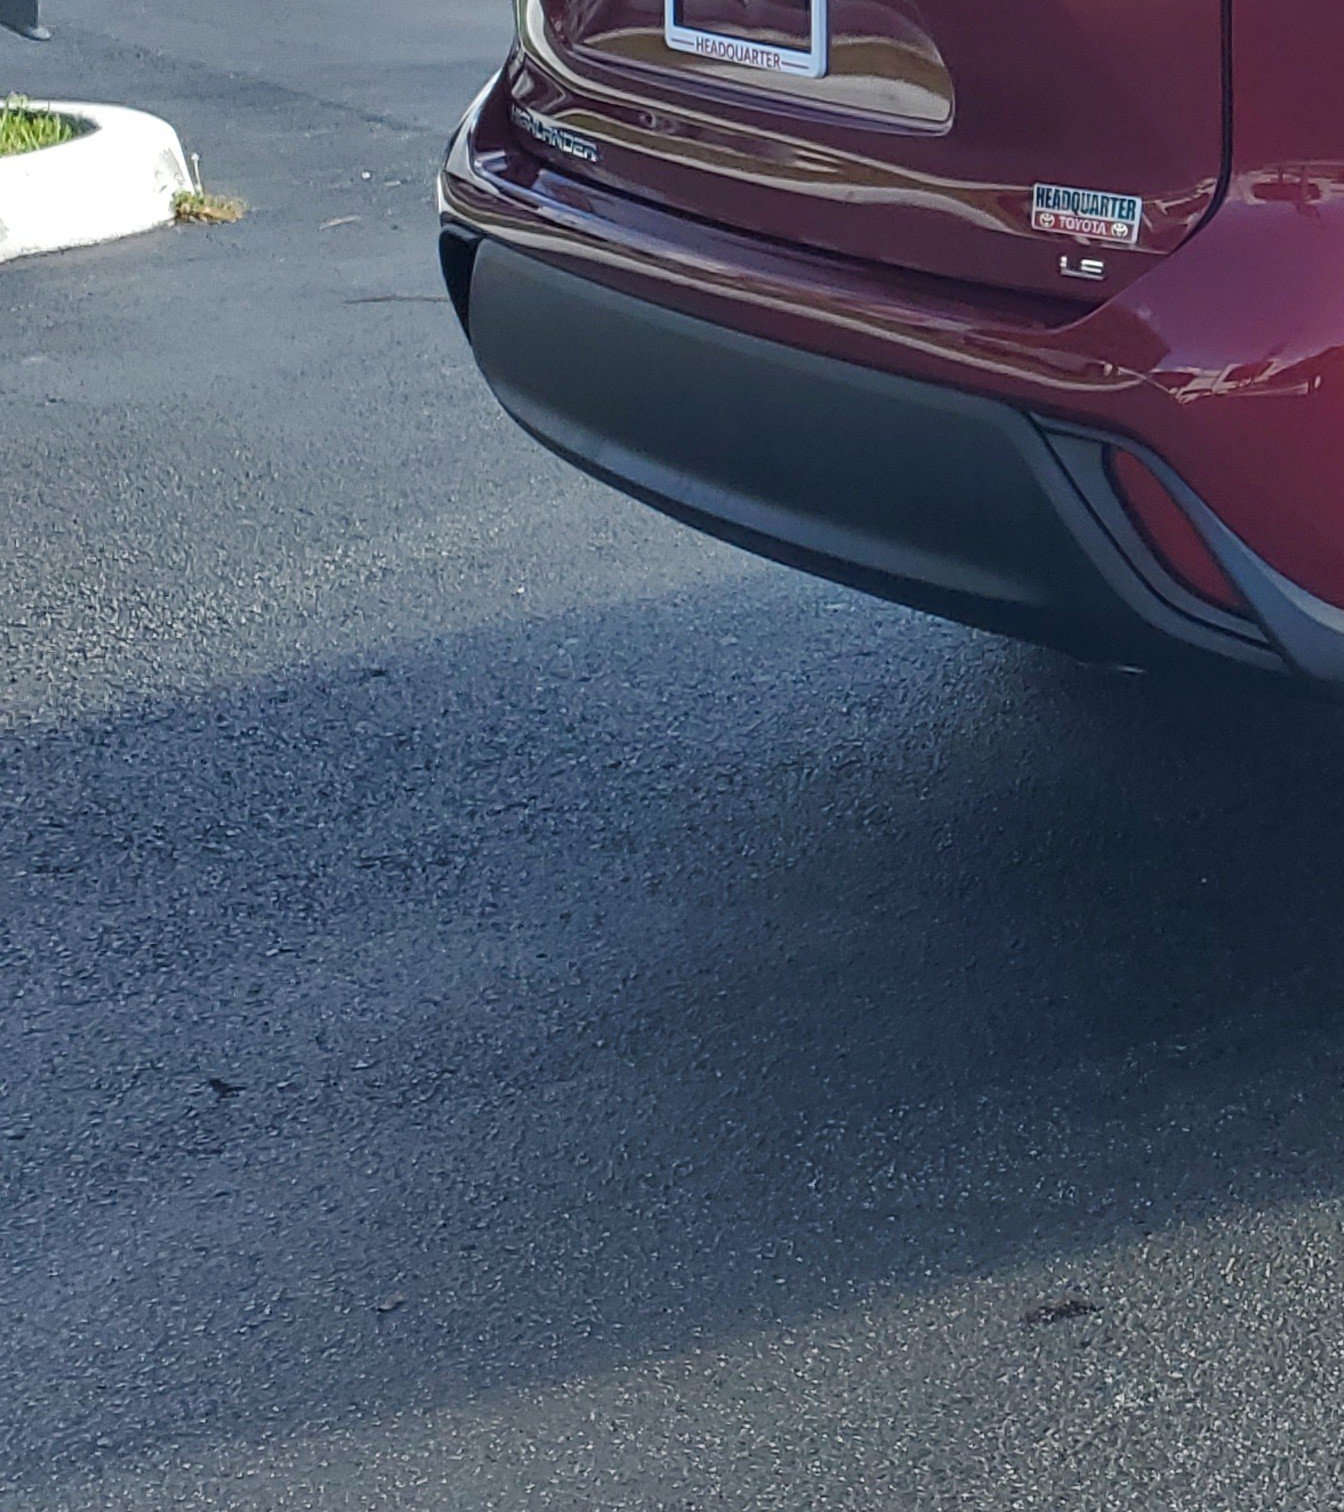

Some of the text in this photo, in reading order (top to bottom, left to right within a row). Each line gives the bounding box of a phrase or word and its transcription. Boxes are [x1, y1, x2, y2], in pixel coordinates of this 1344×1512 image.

[696, 37, 782, 70] HEADQUARTER
[1036, 186, 1137, 221] HEADQUARTER
[1060, 216, 1107, 235] TOYOTA
[1060, 255, 1104, 281] LE
